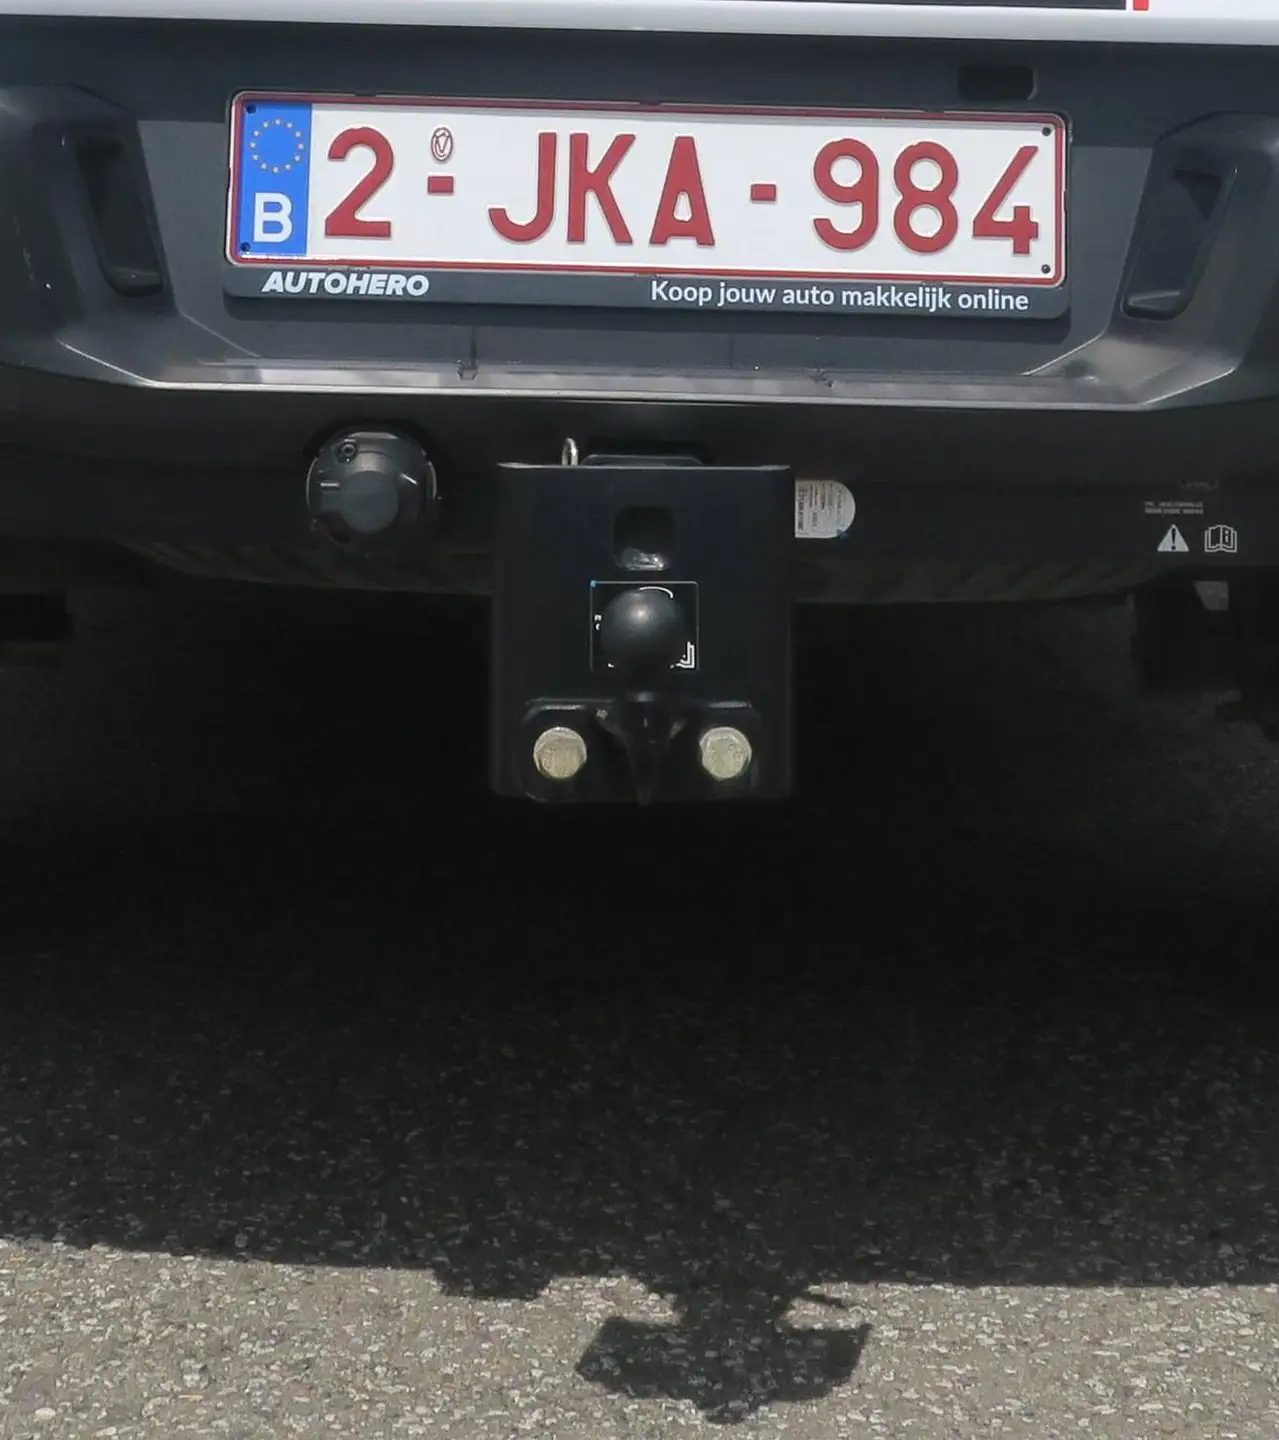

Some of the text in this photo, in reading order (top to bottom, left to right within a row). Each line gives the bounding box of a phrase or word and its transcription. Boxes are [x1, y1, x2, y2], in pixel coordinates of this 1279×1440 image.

[252, 192, 294, 243] B
[261, 271, 430, 296] AUTOHERO
[651, 280, 1029, 311] Koop jouw auto makkelijk online
